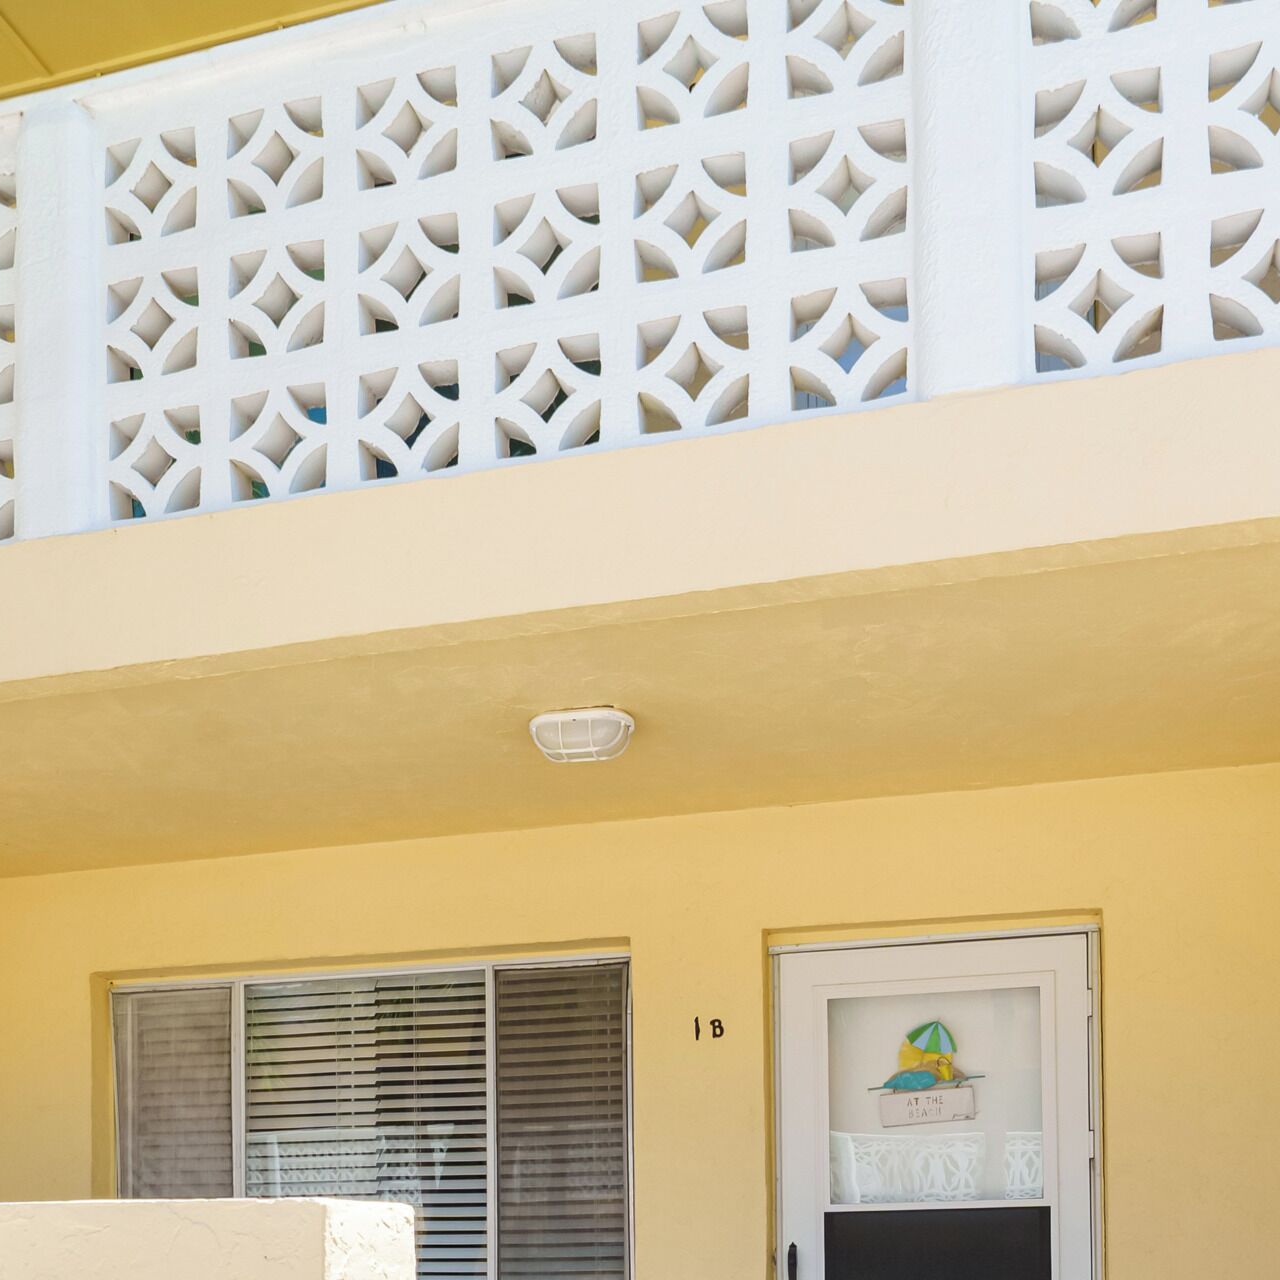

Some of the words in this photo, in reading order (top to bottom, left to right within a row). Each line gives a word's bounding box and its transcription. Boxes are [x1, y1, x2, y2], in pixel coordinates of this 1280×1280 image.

[907, 1097, 919, 1106] AT
[925, 1096, 943, 1105] THE
[908, 1107, 942, 1119] BEACH
